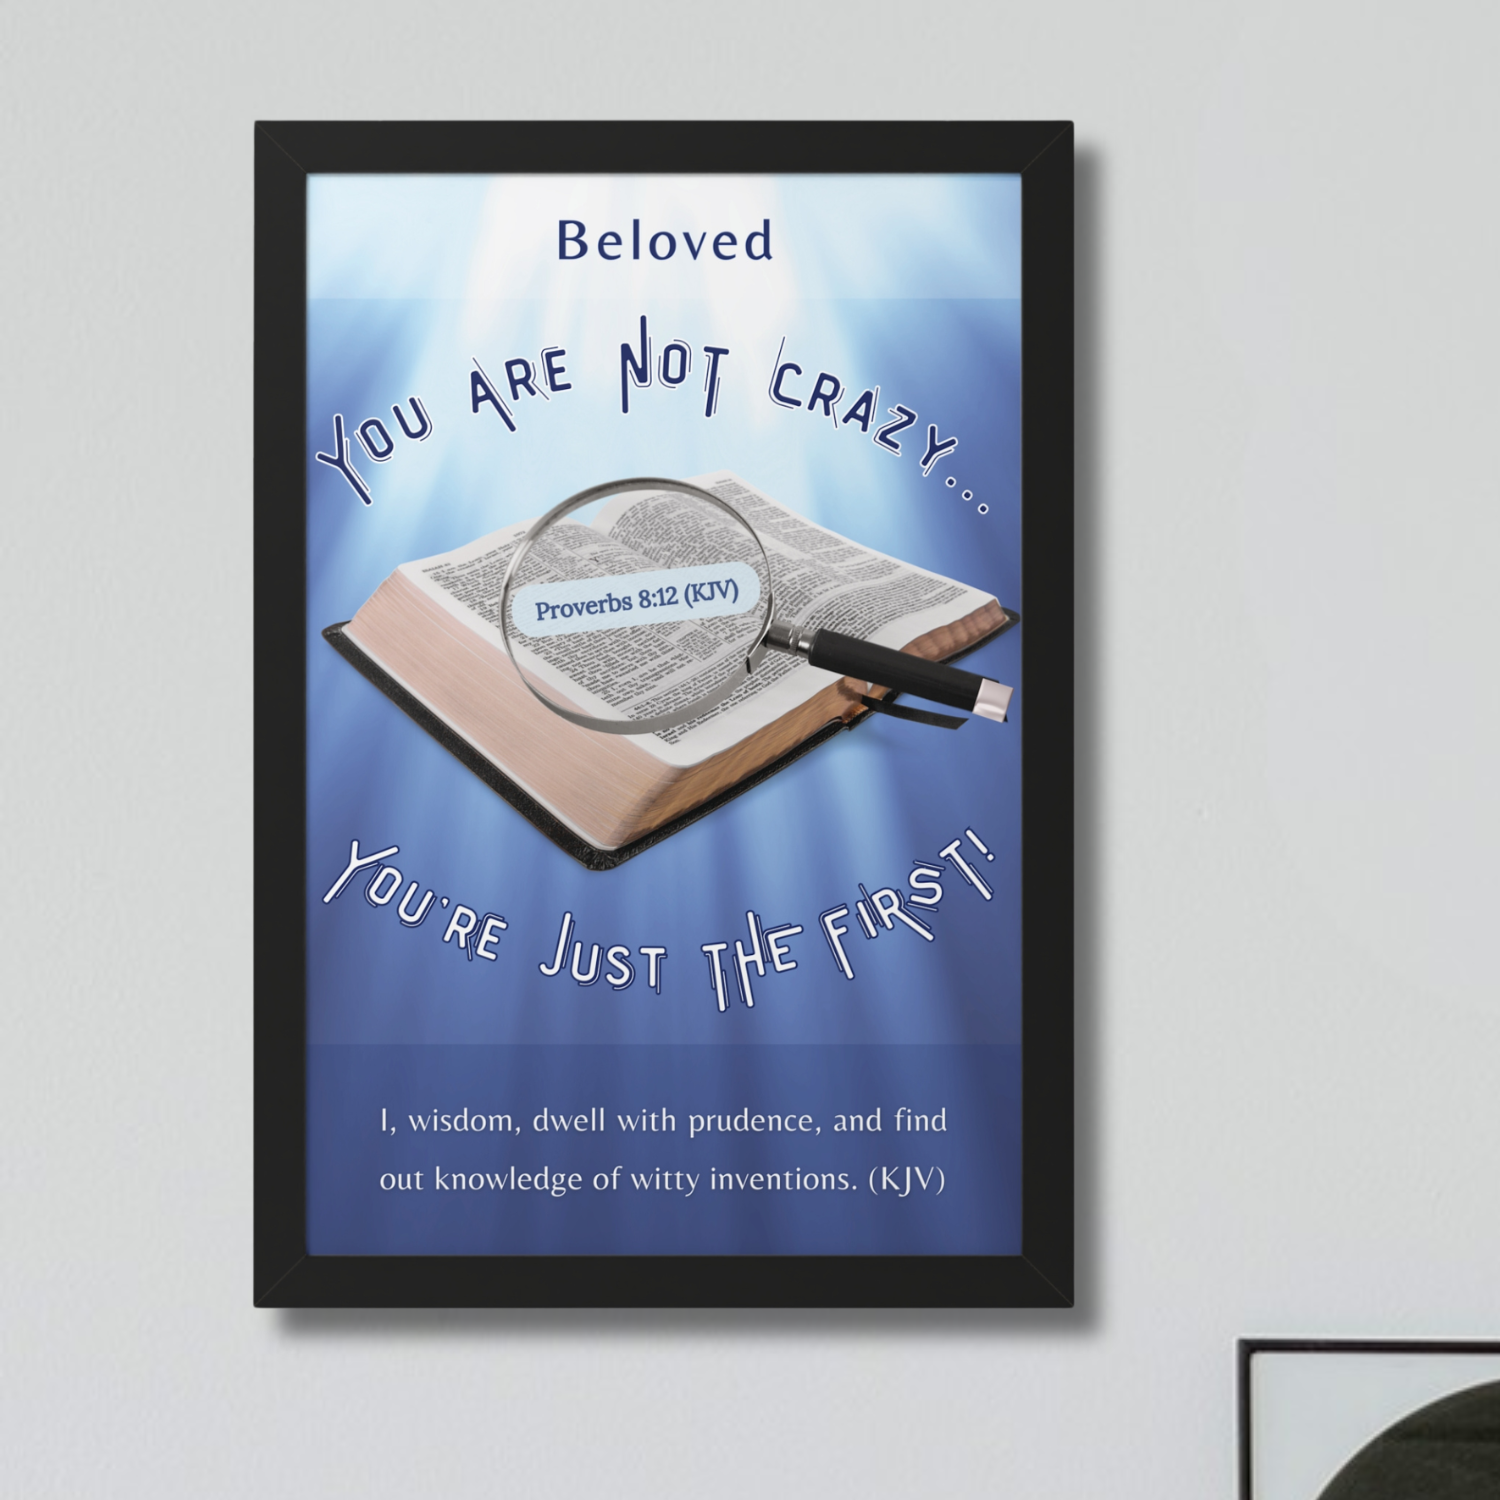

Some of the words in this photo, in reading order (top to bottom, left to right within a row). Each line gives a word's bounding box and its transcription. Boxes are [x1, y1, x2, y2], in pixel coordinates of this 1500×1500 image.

[558, 218, 774, 262] Beloved
[315, 395, 434, 507] YOU
[469, 345, 573, 434] ARE
[620, 314, 731, 419] NOT
[535, 592, 634, 622] Proverbs
[638, 585, 680, 609] 8:12
[684, 578, 740, 609] (KJV)
[321, 838, 509, 963] YOU'RE
[538, 910, 669, 996] JUST
[701, 909, 805, 1014] THE
[817, 826, 998, 982] FIRST!
[381, 1107, 397, 1136] I,
[408, 1107, 522, 1136] wisdom,
[532, 1107, 606, 1132] dwell
[616, 1107, 677, 1132] with
[688, 1107, 822, 1139] prudence,
[833, 1107, 883, 1132] and
[893, 1107, 948, 1132] find
[379, 1170, 425, 1191] out
[434, 1165, 583, 1198] knowledge
[592, 1165, 624, 1191] of
[630, 1166, 701, 1198] witty
[710, 1166, 858, 1191] inventions.
[868, 1165, 946, 1198] (KJV)
